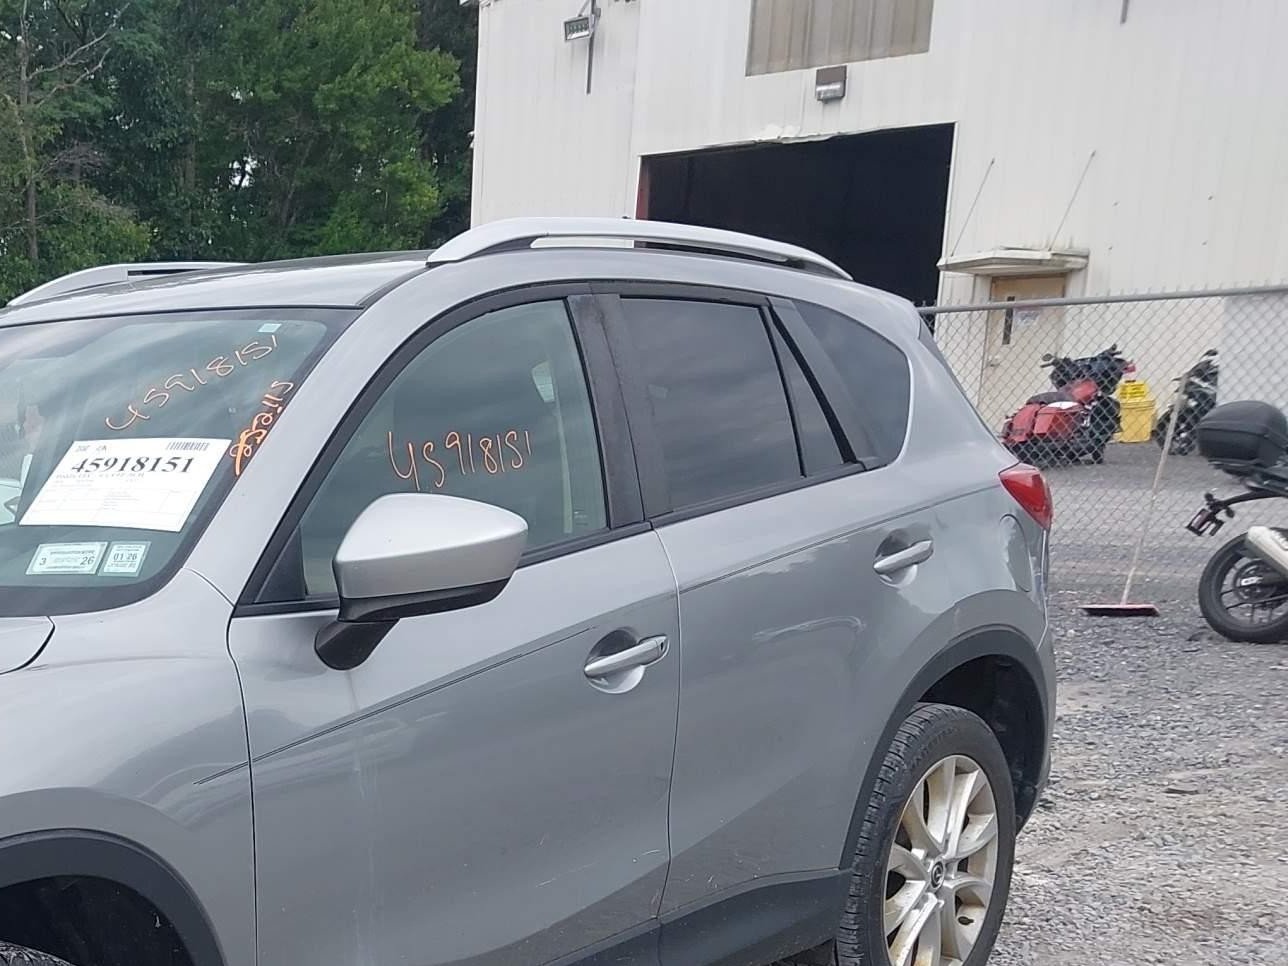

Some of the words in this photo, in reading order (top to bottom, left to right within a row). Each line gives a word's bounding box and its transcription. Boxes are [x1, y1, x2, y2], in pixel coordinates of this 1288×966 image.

[105, 335, 278, 430] 45918151
[71, 456, 195, 473] 45918151
[387, 430, 531, 491] 45918151
